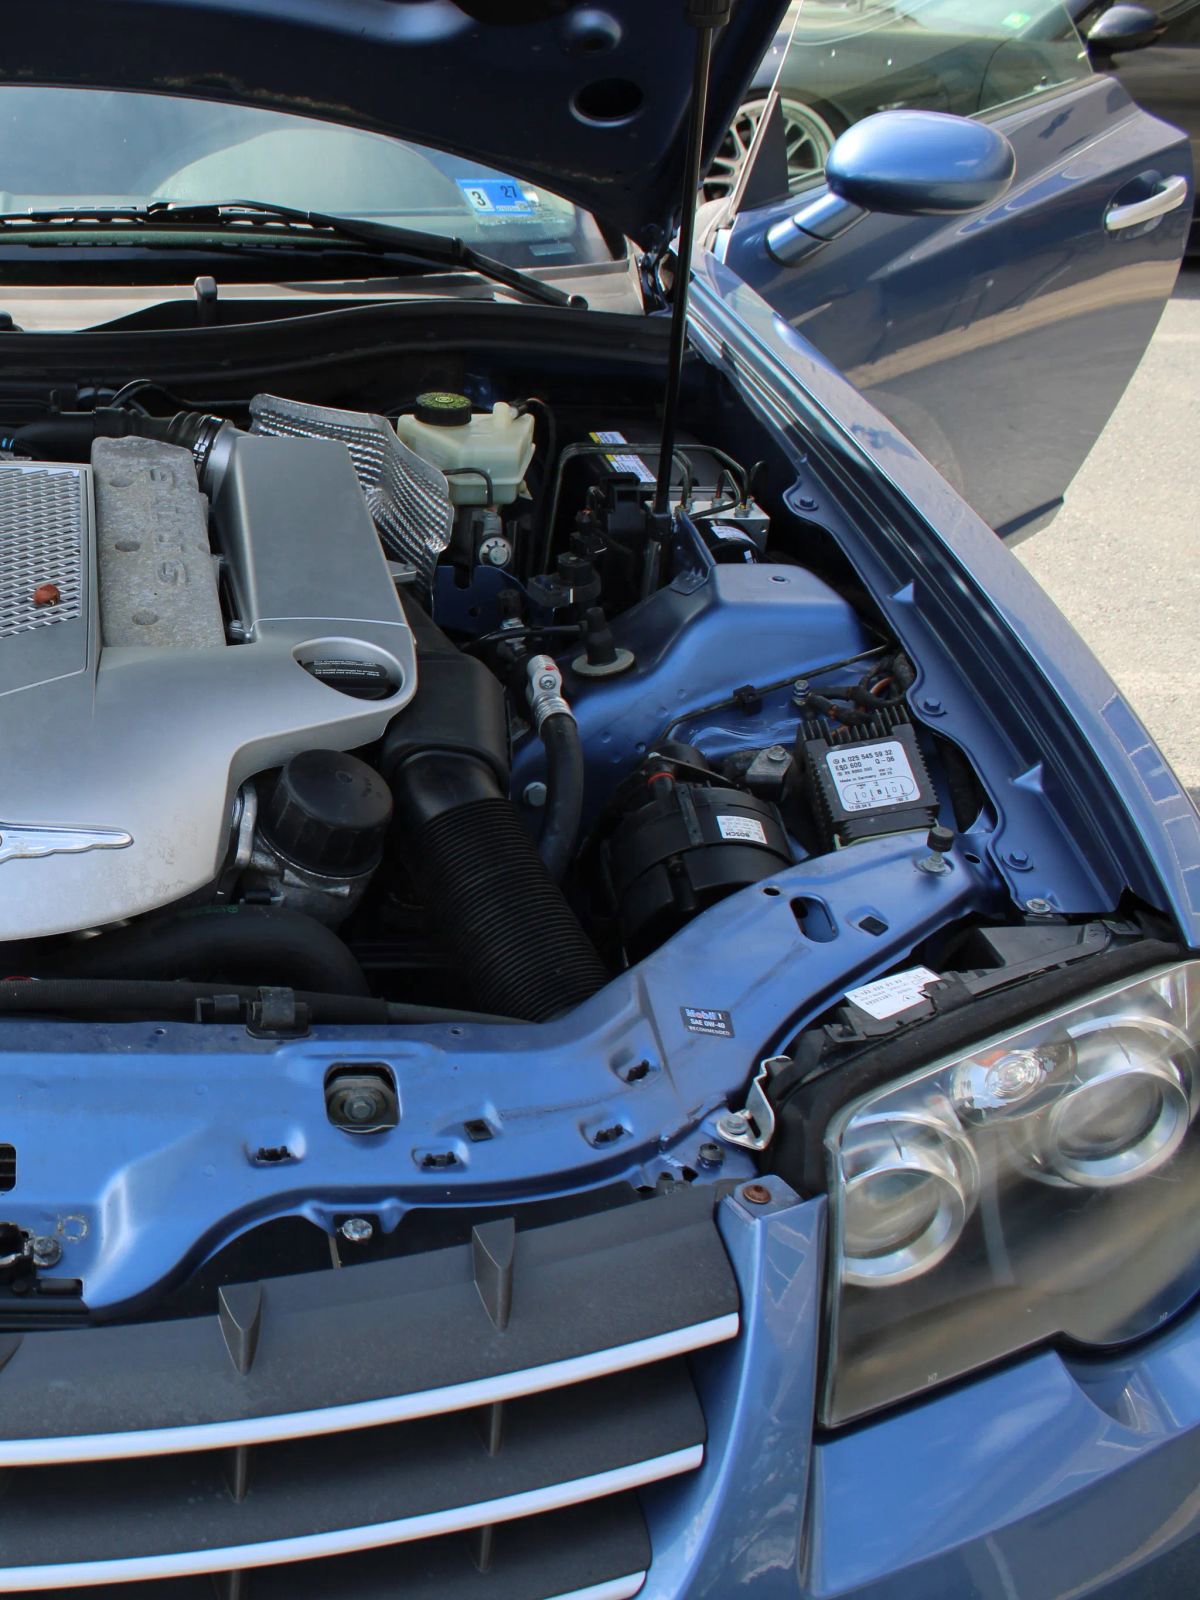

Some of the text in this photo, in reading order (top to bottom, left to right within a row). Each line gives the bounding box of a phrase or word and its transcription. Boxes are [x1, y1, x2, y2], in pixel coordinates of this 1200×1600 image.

[471, 185, 518, 207] 3 27
[685, 1008, 716, 1020] Mobil
[690, 1018, 704, 1026] SAE
